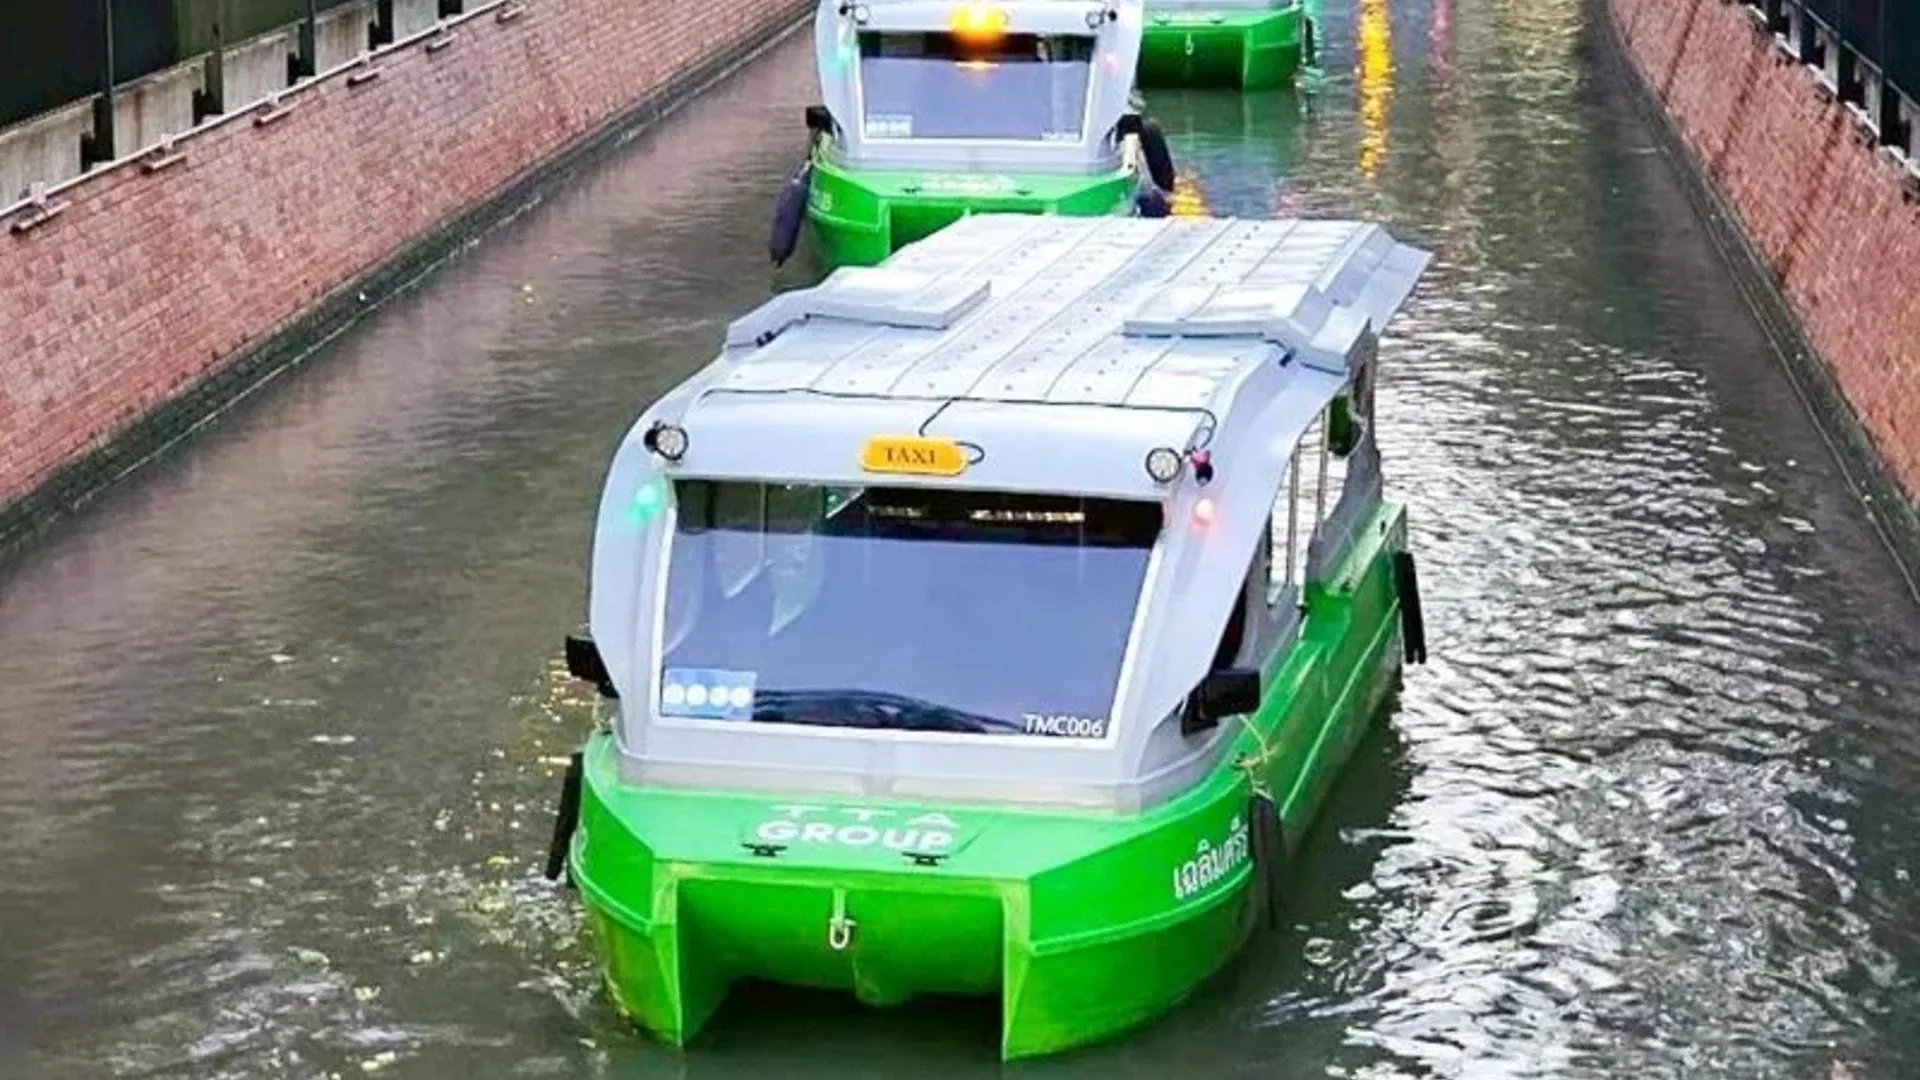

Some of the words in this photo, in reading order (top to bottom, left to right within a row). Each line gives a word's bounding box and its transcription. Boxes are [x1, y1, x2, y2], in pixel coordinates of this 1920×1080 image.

[884, 446, 935, 464] TAXI
[1021, 712, 1103, 736] TMC006
[757, 820, 954, 851] GROUP
